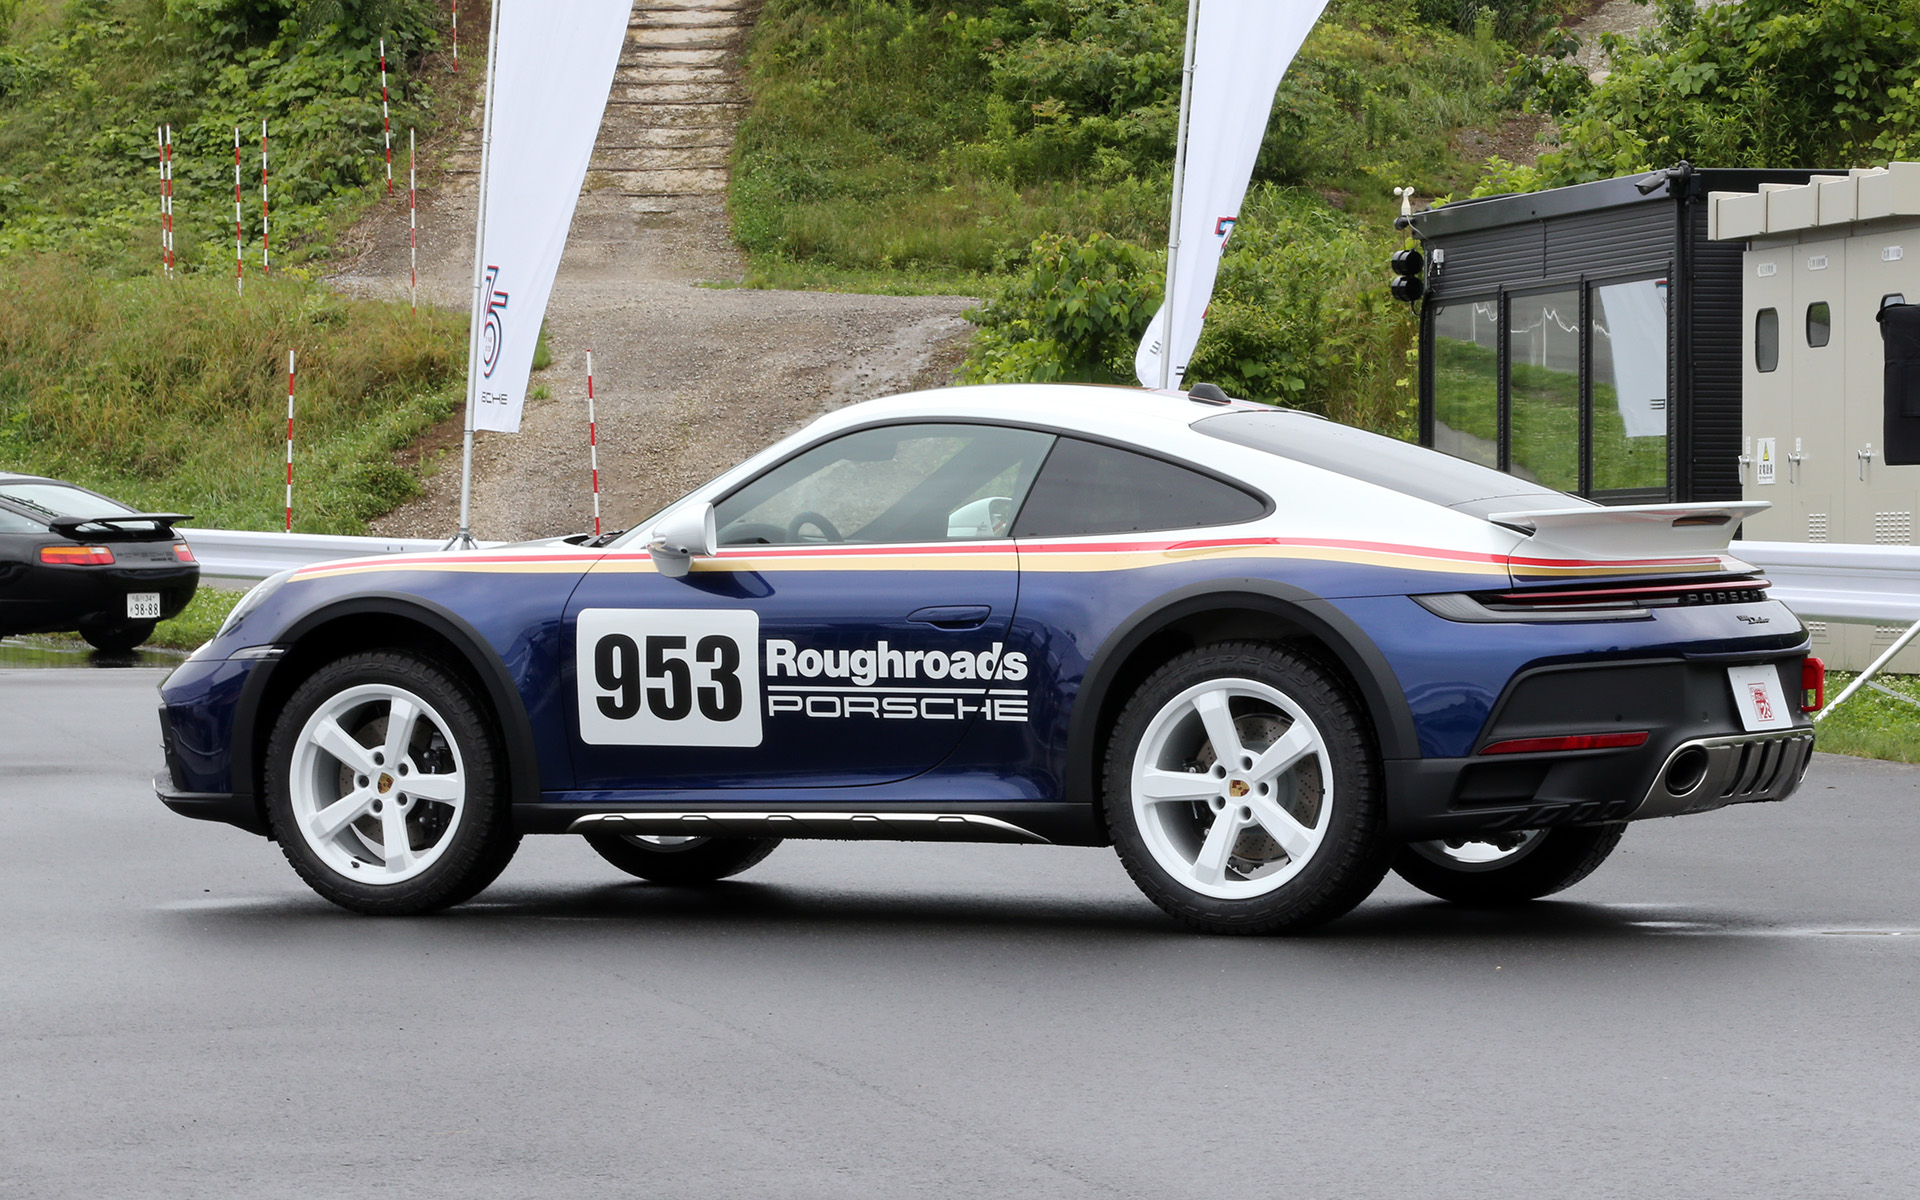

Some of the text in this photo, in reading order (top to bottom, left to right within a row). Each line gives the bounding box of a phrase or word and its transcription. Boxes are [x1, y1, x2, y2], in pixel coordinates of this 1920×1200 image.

[481, 391, 508, 405] SCHE
[1688, 590, 1767, 602] PORSCHE
[766, 639, 1028, 686] Roughroads
[594, 633, 742, 720] 953
[768, 695, 1028, 721] PORSCHE
